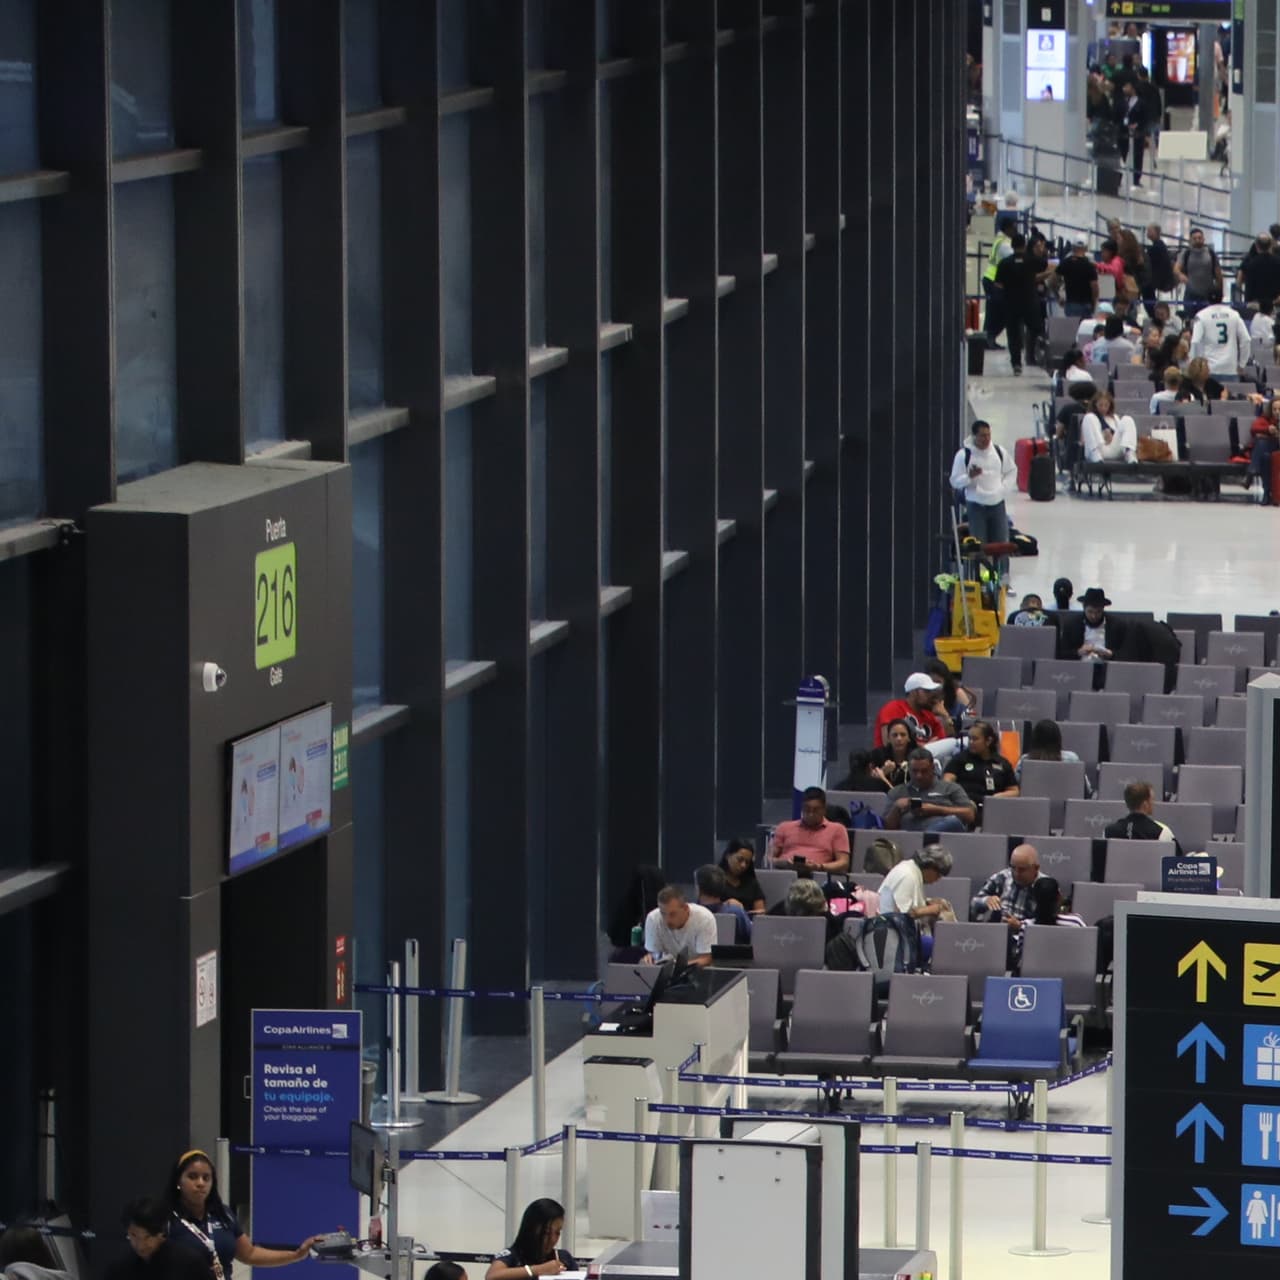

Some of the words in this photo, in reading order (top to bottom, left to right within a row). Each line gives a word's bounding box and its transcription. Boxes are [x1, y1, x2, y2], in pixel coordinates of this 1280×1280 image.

[1216, 322, 1228, 344] 3
[265, 518, 287, 543] Puerta
[256, 564, 294, 647] 216
[269, 667, 283, 686] Gate
[1176, 862, 1197, 870] Copa
[263, 1025, 331, 1036] CopaAirlines
[264, 1063, 303, 1075] Revisa
[305, 1063, 317, 1074] el
[264, 1078, 310, 1088] tamaño
[312, 1078, 328, 1088] de
[264, 1091, 276, 1101] tu
[279, 1091, 335, 1104] equipaje.
